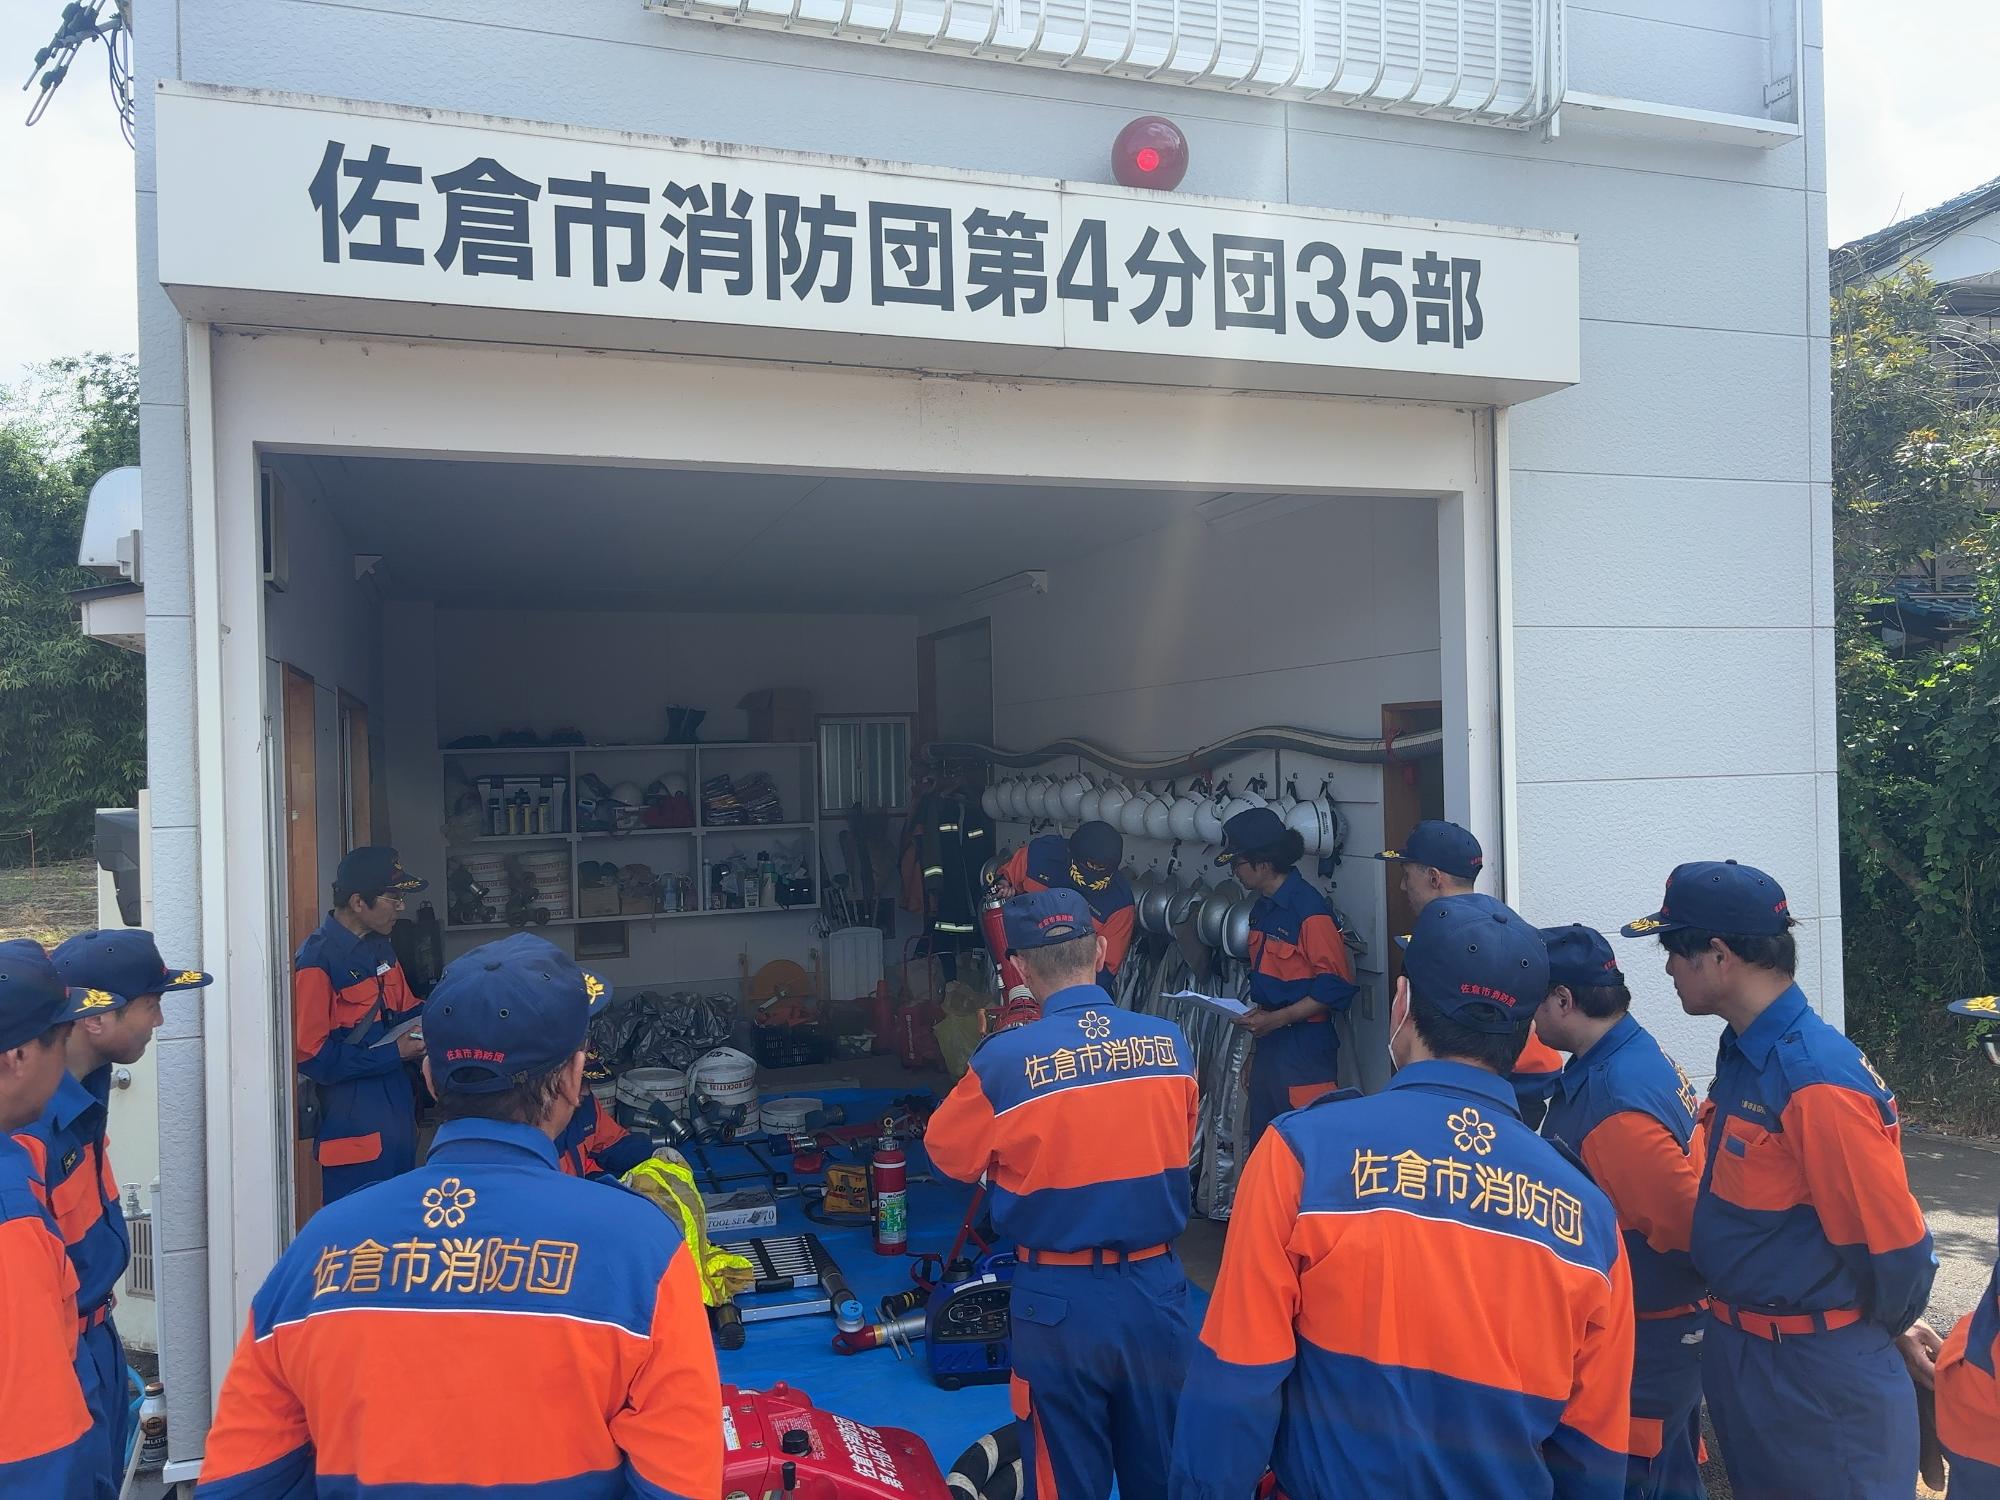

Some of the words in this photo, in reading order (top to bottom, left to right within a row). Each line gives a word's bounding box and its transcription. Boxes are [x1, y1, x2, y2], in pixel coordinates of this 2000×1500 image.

[307, 138, 1484, 349] 佐倉市消防団第4分団35部
[1459, 983, 1517, 1008] 佐倉市消防団
[1025, 1035, 1179, 1090] 佐倉市消防団
[1350, 1148, 1584, 1246] 佐倉市消防団
[312, 1236, 579, 1300] 佐倉市消防団
